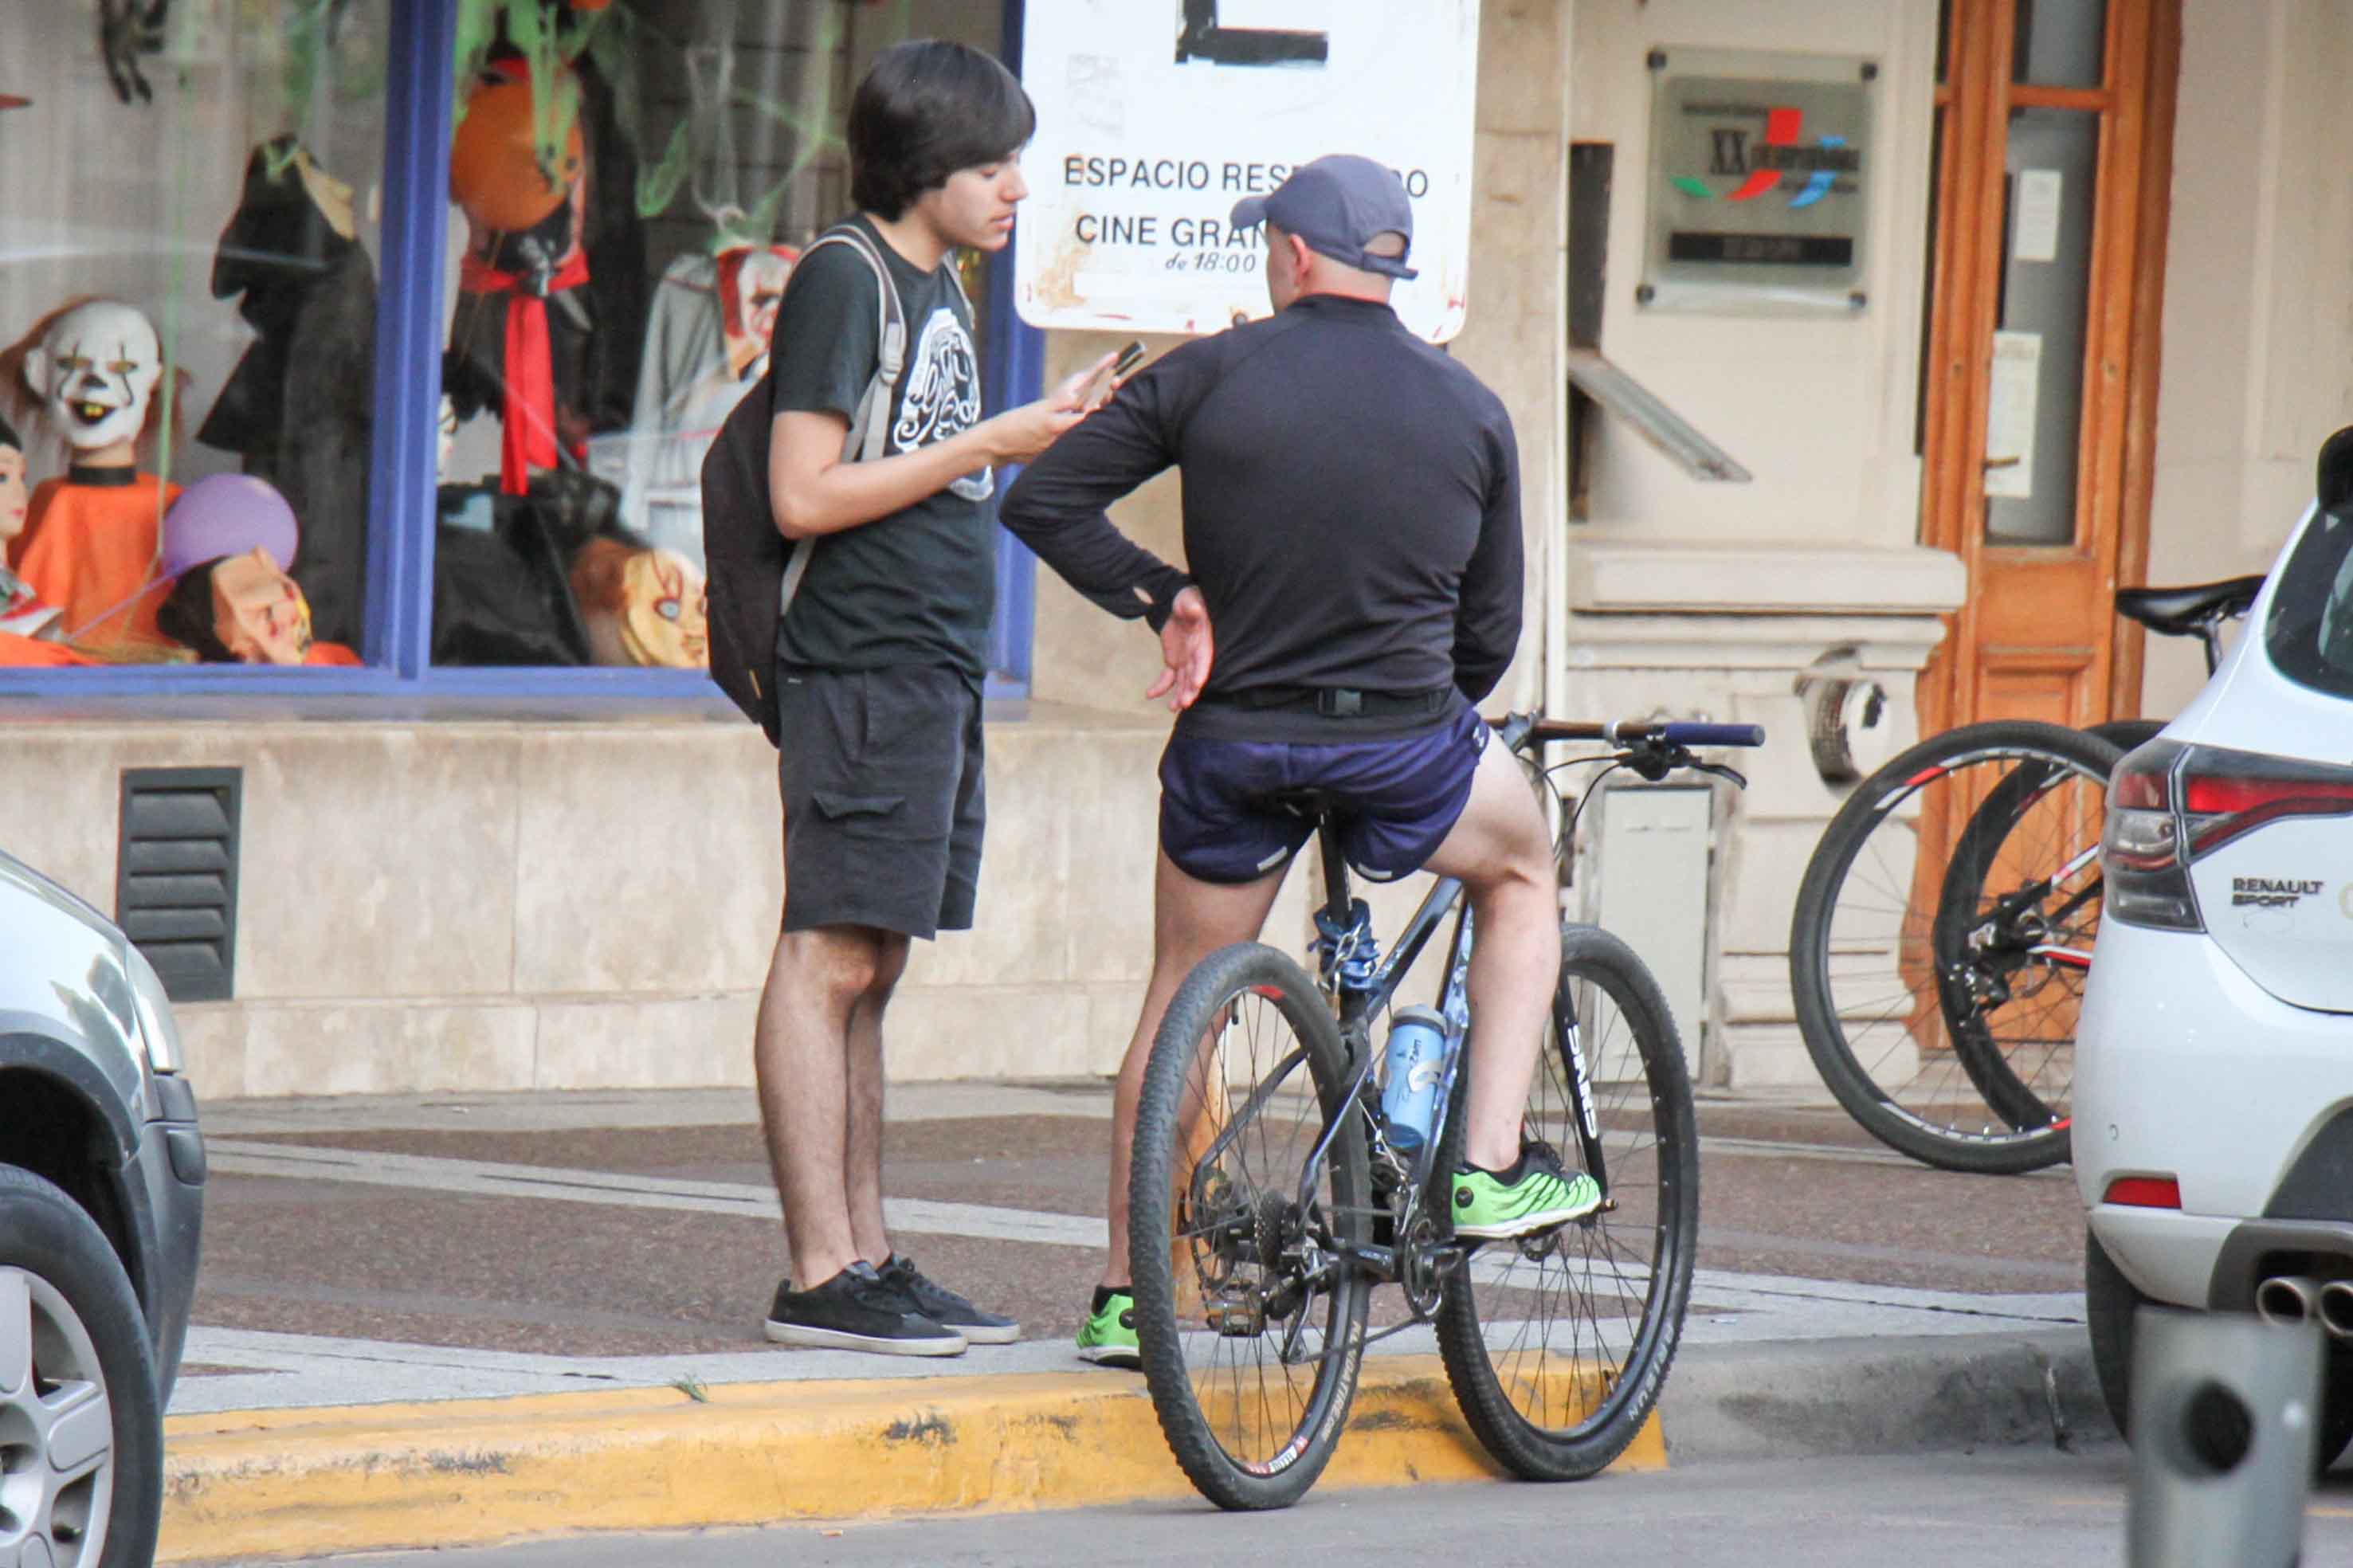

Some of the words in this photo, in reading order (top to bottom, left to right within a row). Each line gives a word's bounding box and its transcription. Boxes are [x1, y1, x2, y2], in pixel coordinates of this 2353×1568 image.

[1063, 156, 1210, 190] ESPACIO
[1076, 214, 1158, 245] CINE
[1194, 251, 1257, 273] 18:00
[2233, 876, 2324, 895] RENAULT
[2232, 892, 2300, 907] SPORT
